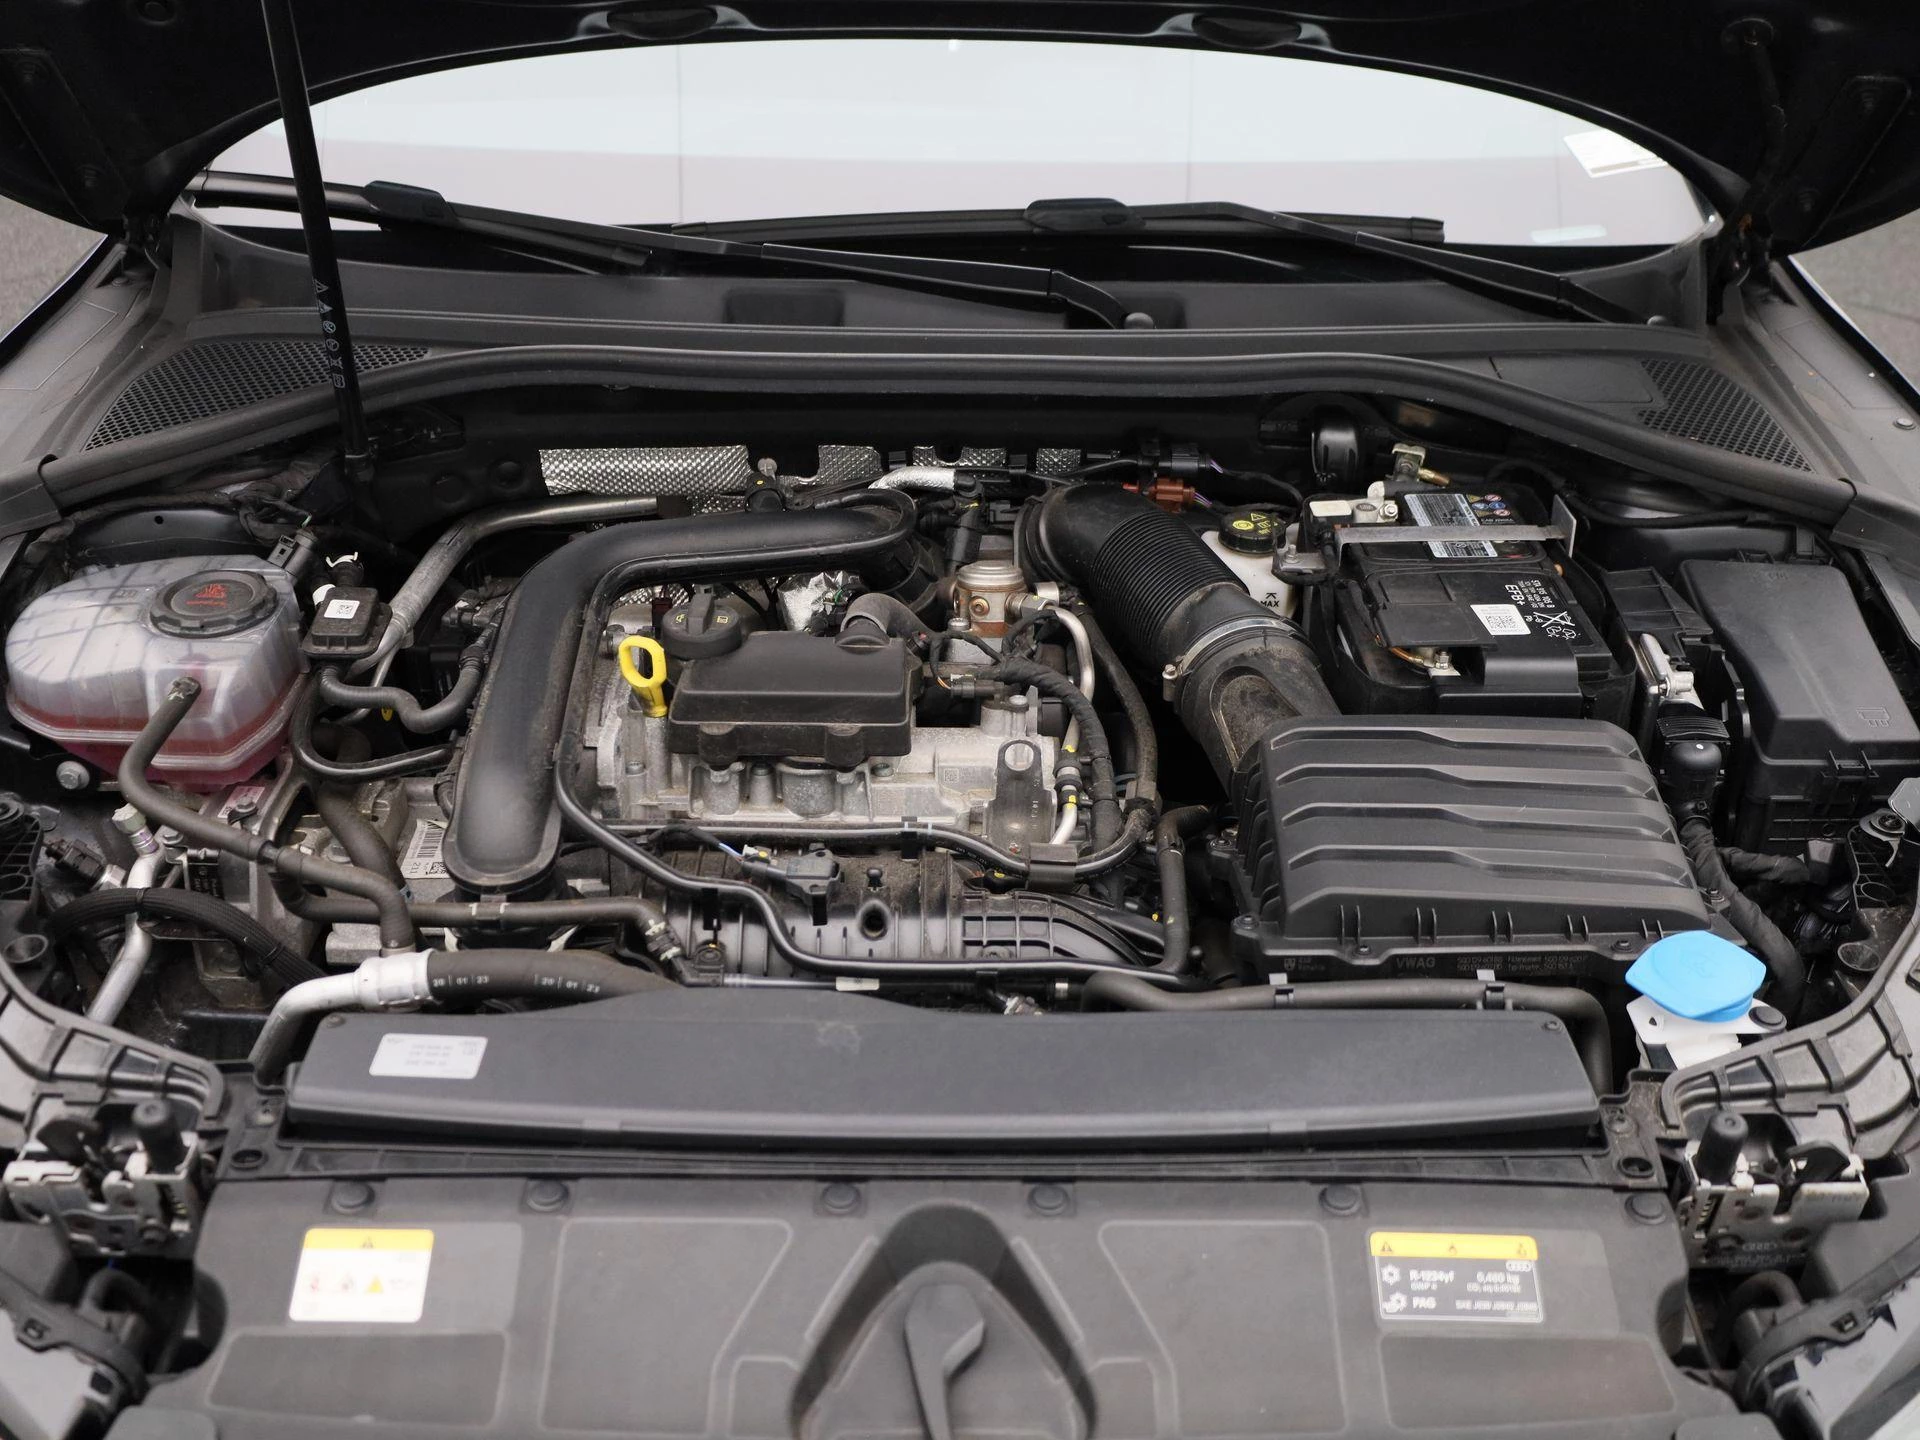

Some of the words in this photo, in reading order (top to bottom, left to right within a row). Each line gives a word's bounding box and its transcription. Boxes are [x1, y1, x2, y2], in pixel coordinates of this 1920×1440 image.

[1504, 584, 1526, 606] EFB+
[1260, 600, 1280, 608] MAX
[1395, 956, 1436, 969] VWAG
